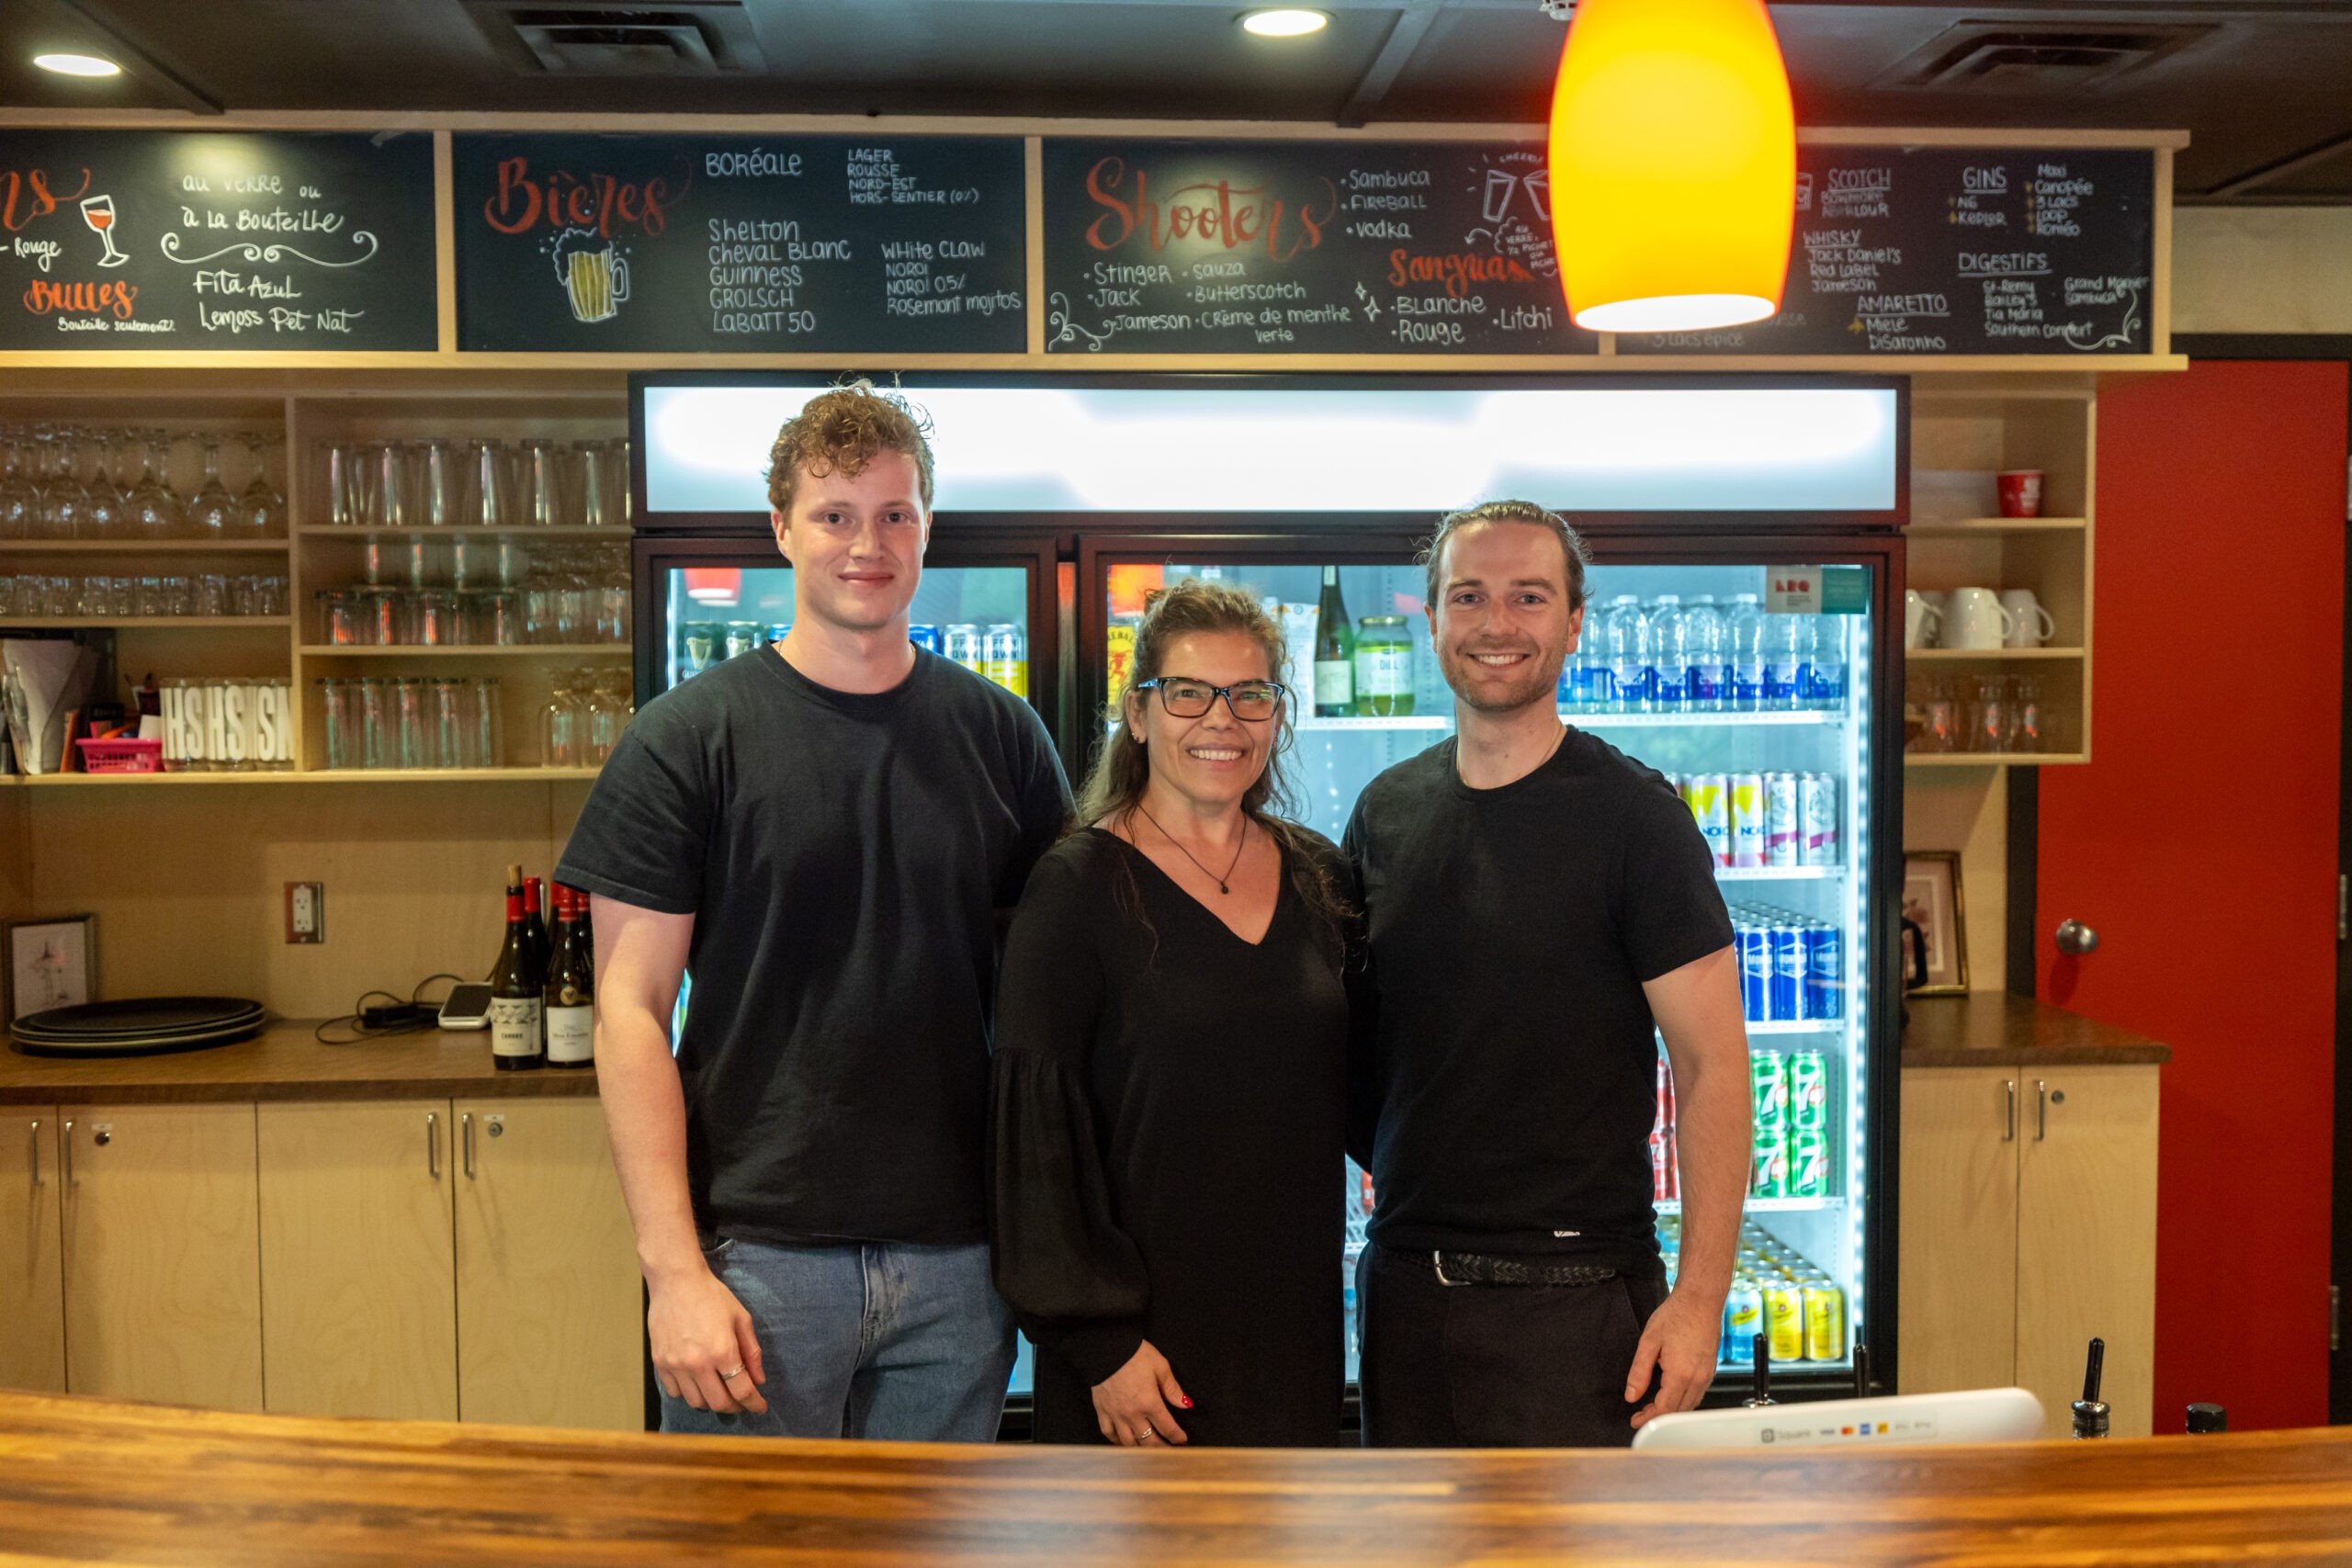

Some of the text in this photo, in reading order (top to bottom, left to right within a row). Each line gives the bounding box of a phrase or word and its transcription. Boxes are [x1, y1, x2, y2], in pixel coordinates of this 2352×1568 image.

[848, 149, 894, 163] LAGER
[847, 164, 900, 176] ROUSSE
[1350, 169, 1430, 189] Sambuca
[1828, 168, 1892, 189] SCOTCH
[1963, 165, 2007, 189] GINS
[183, 175, 209, 192] au
[299, 186, 321, 198] ou
[849, 177, 917, 190] NORD-EST
[485, 156, 666, 239] Bières
[181, 206, 199, 227] à
[1085, 156, 1337, 265] Shooters
[1804, 229, 1861, 244] WHISKY
[193, 268, 244, 294] Fita
[710, 288, 794, 310] GROLSCH
[1094, 281, 1306, 308] Jack Butterscotch
[1858, 293, 1948, 312] AMARETTO
[268, 306, 311, 333] Pet
[318, 309, 365, 333] Nat
[788, 310, 815, 333] 50
[1114, 315, 1191, 330] Jameson
[1260, 307, 1283, 324] de
[1287, 304, 1351, 322] menthe
[1501, 305, 1554, 331] Litchi
[1255, 328, 1295, 344] verte
[1399, 319, 1465, 345] Rouge
